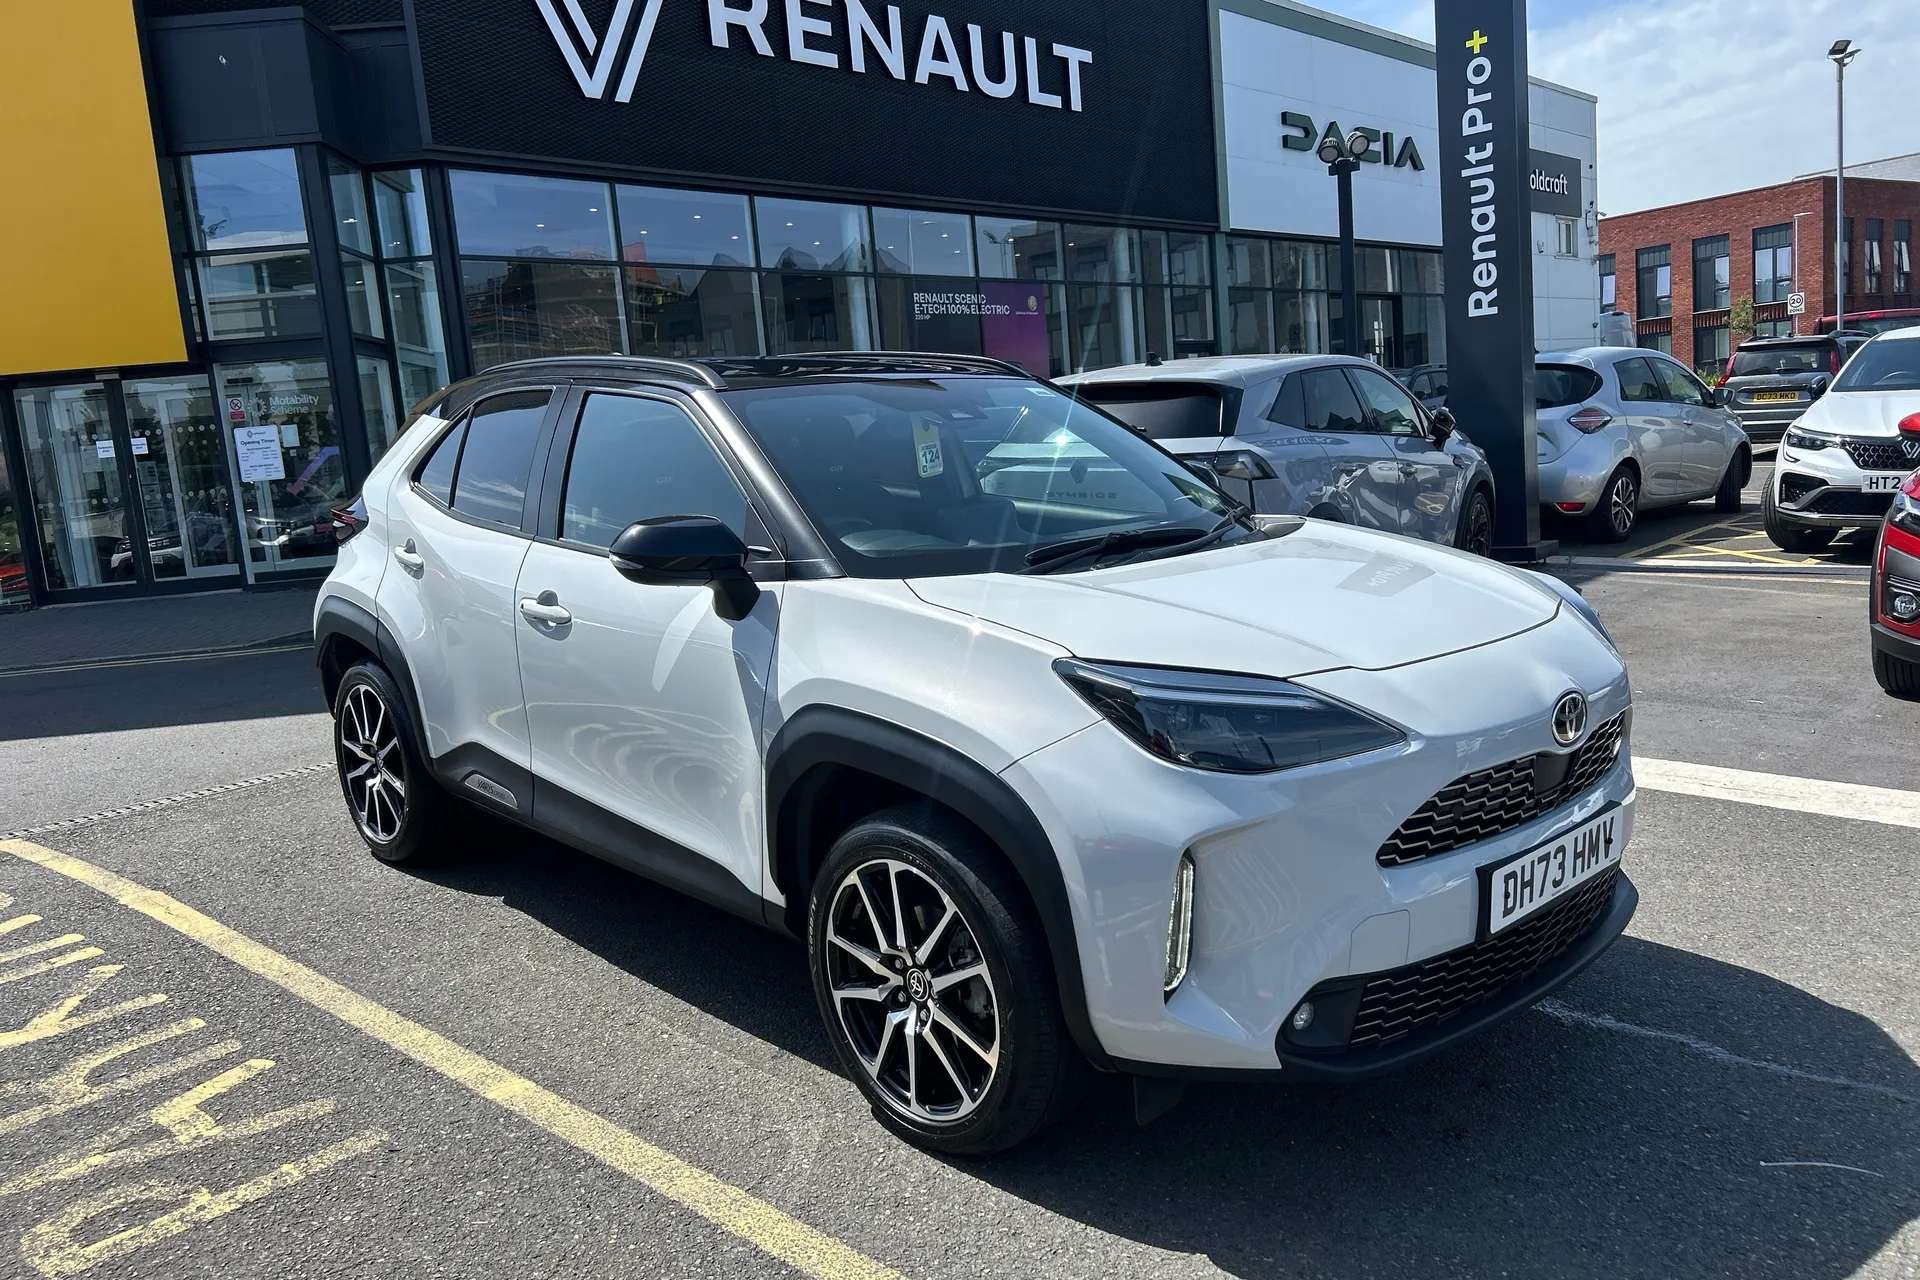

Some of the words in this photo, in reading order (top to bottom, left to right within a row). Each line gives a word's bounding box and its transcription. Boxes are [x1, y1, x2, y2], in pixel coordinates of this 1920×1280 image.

[708, 0, 1092, 112] RENAULT
[1462, 29, 1493, 136] Pro+
[1461, 141, 1498, 317] Renault
[913, 293, 953, 303] RENAULT
[914, 304, 947, 314] E-TECH
[947, 304, 970, 315] 100%
[971, 304, 1010, 315] ELECTRIC
[269, 394, 319, 406] Motability
[270, 405, 309, 415] Scheme
[1503, 844, 1567, 919] DH73
[1572, 815, 1615, 878] HMV
